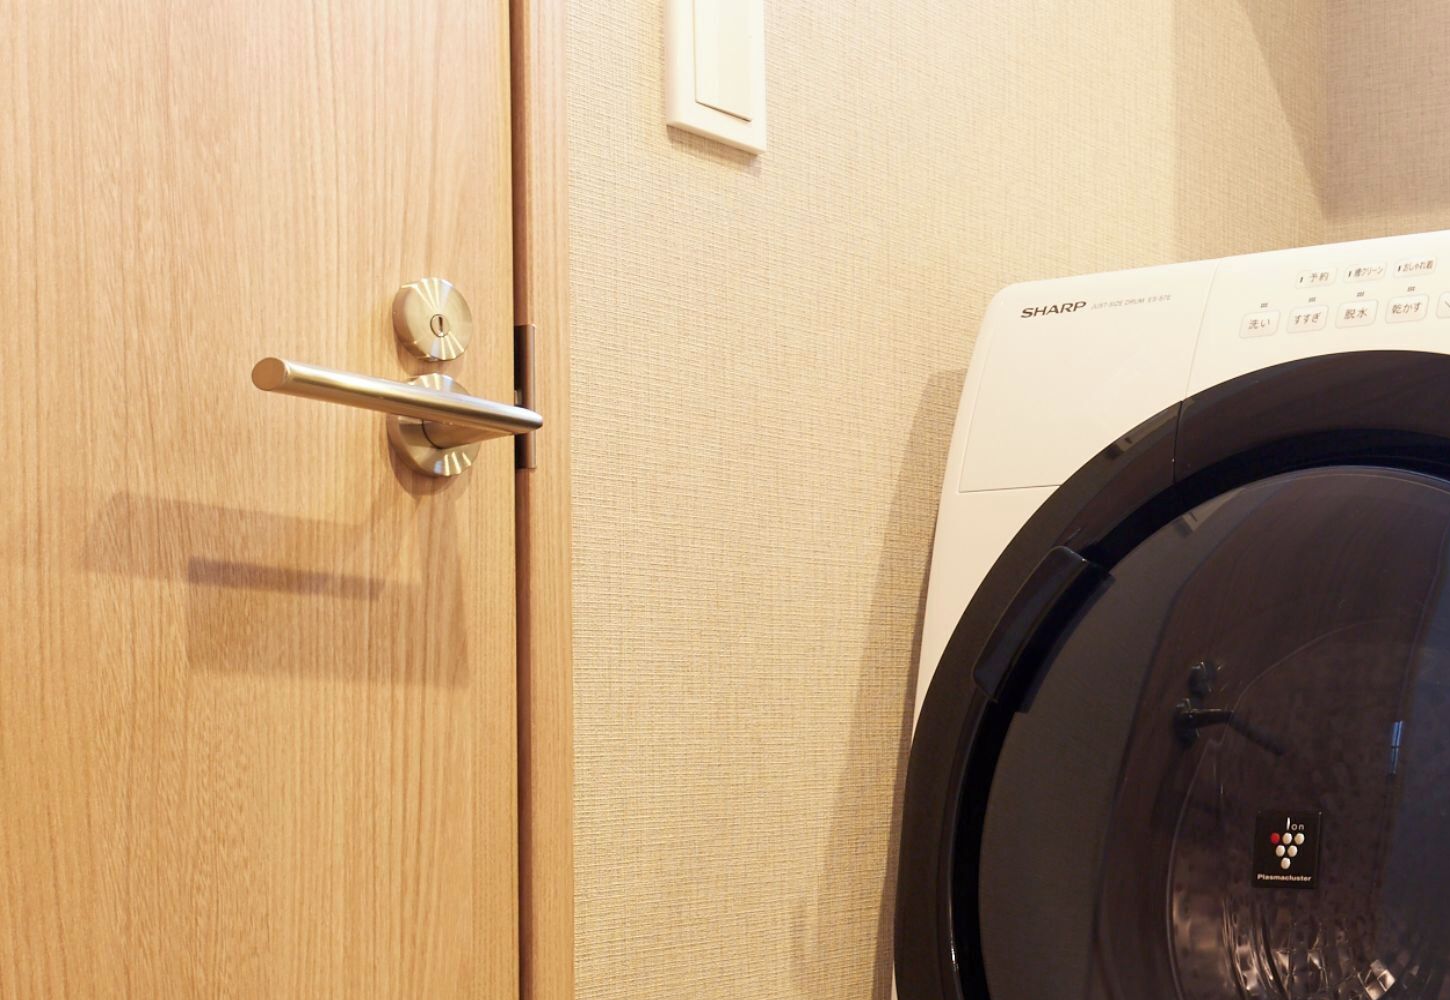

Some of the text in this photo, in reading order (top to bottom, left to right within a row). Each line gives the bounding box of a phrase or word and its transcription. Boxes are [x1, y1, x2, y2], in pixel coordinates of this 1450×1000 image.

[1309, 272, 1329, 282] 予約
[1021, 301, 1087, 319] SHARP
[1344, 308, 1368, 319] 脱水
[1391, 302, 1422, 314] 乾かす
[1294, 312, 1321, 325] すすぎ
[1248, 319, 1271, 330] 洗い
[1286, 816, 1305, 831] Ion
[1257, 873, 1312, 882] Plasmacluster
